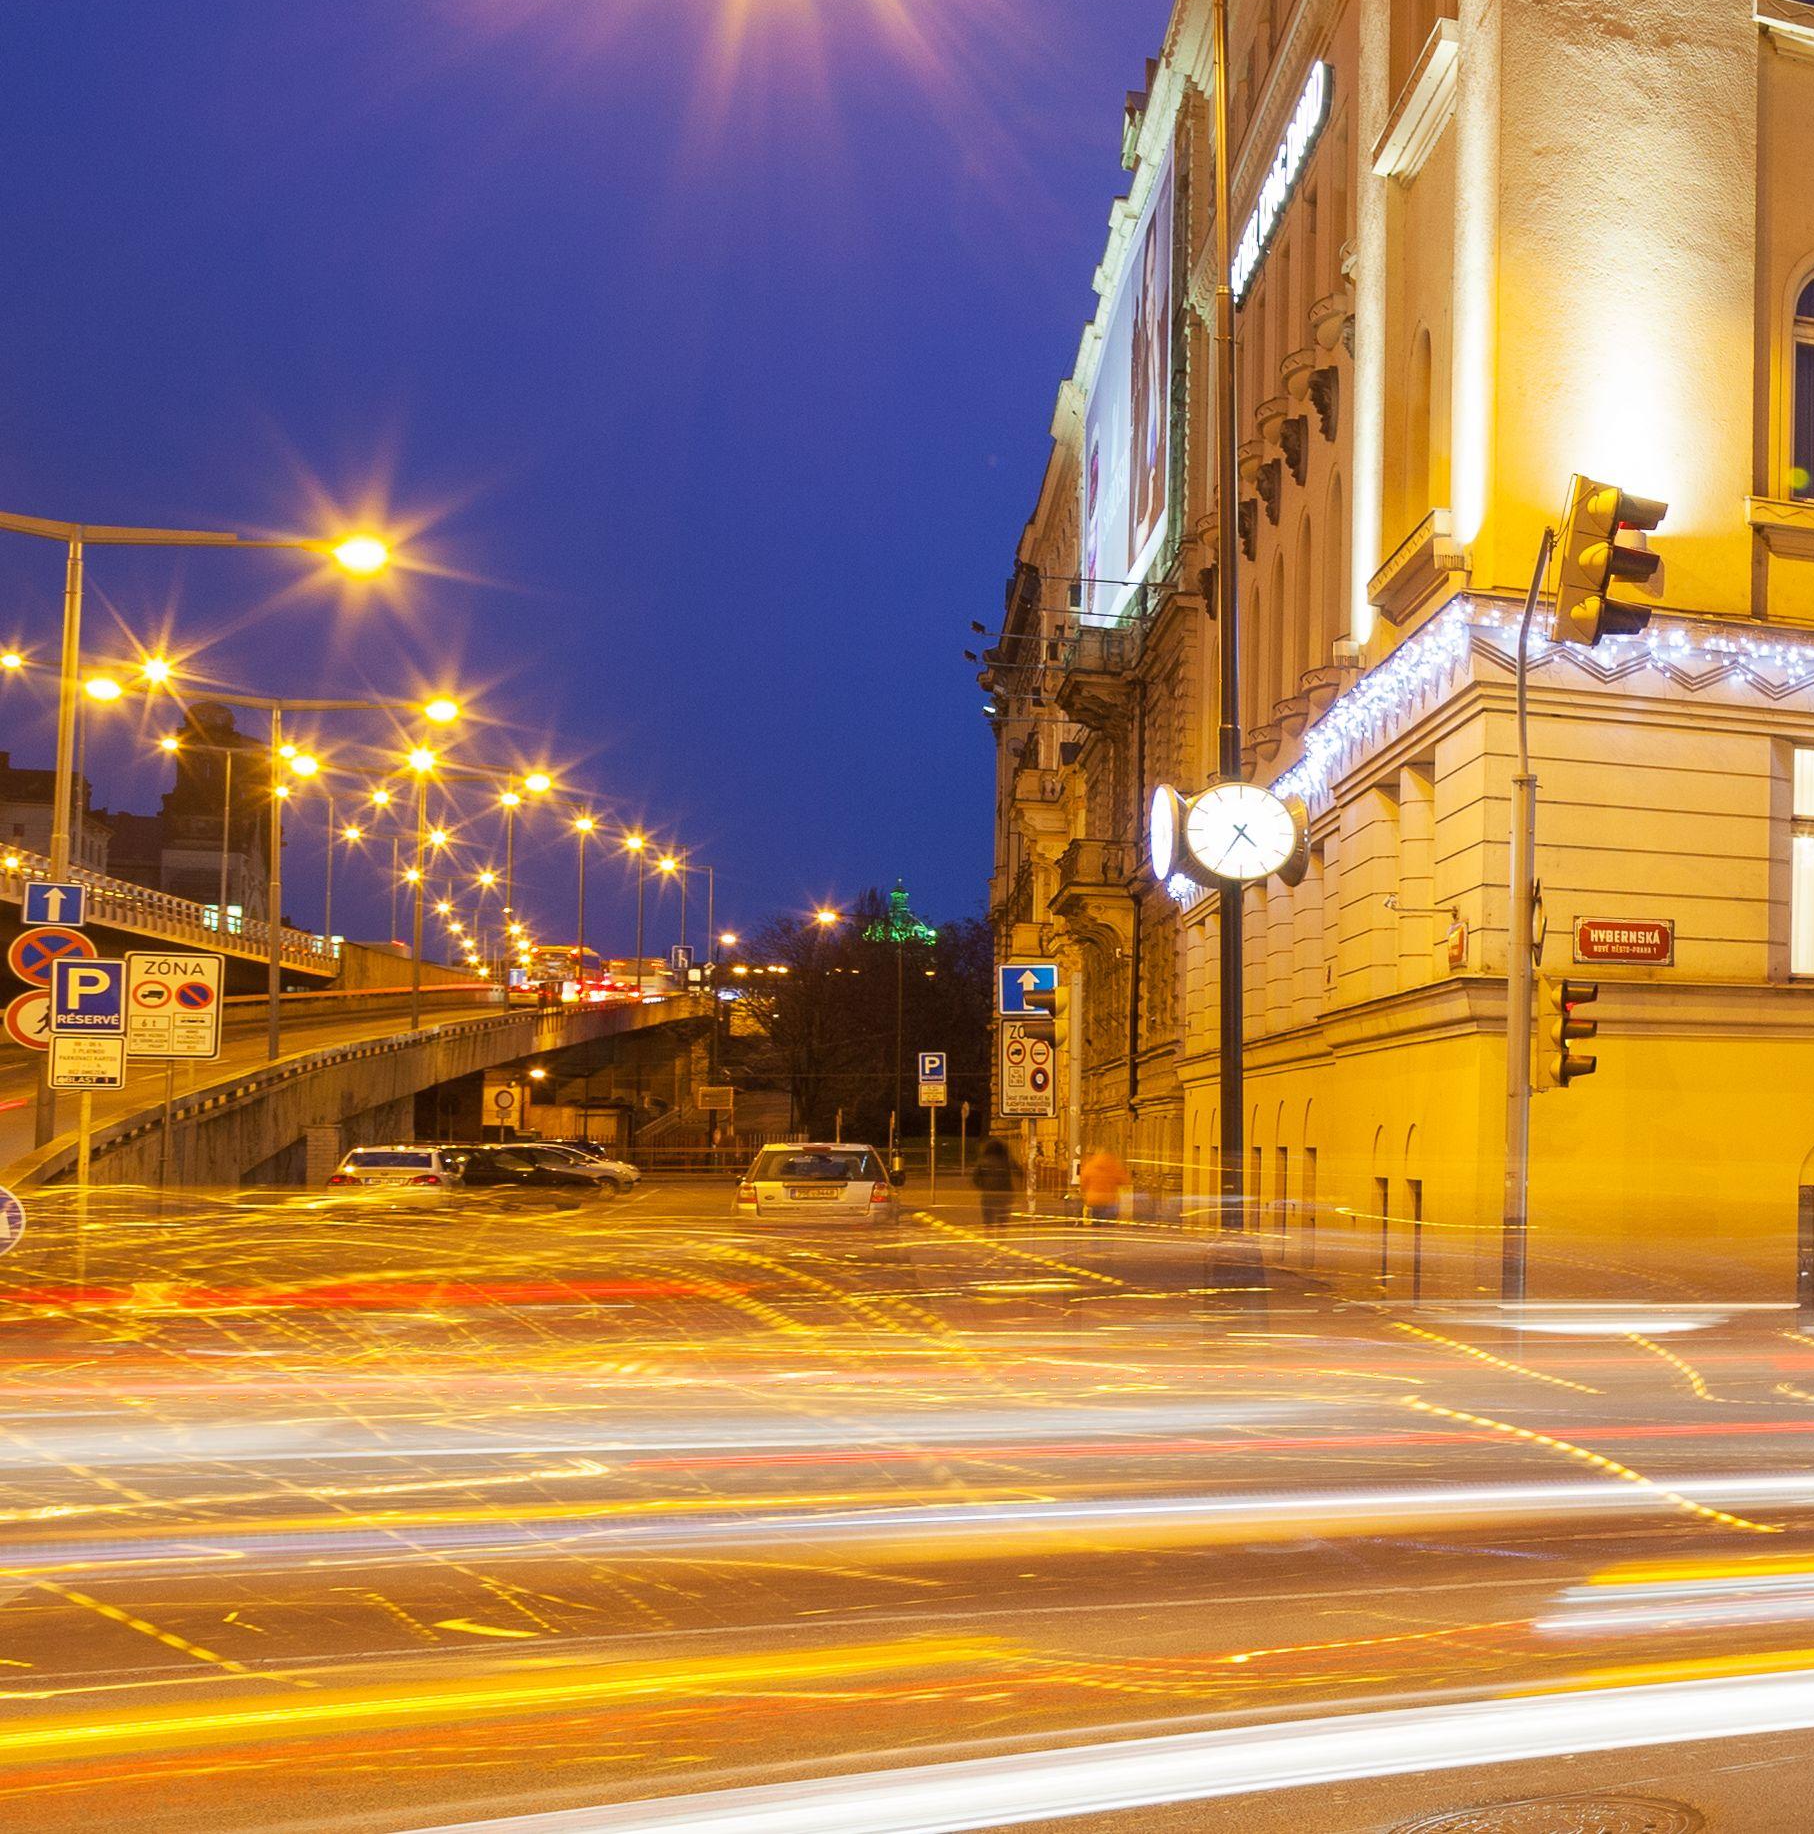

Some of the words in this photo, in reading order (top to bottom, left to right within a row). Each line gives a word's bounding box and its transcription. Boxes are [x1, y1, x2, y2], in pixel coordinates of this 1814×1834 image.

[1590, 929, 1660, 944] HYBERNSKÁ
[144, 959, 205, 976] ZÓNA
[67, 967, 111, 1009] P
[57, 1013, 120, 1025] RÉSERVÉ
[925, 1056, 940, 1074] P
